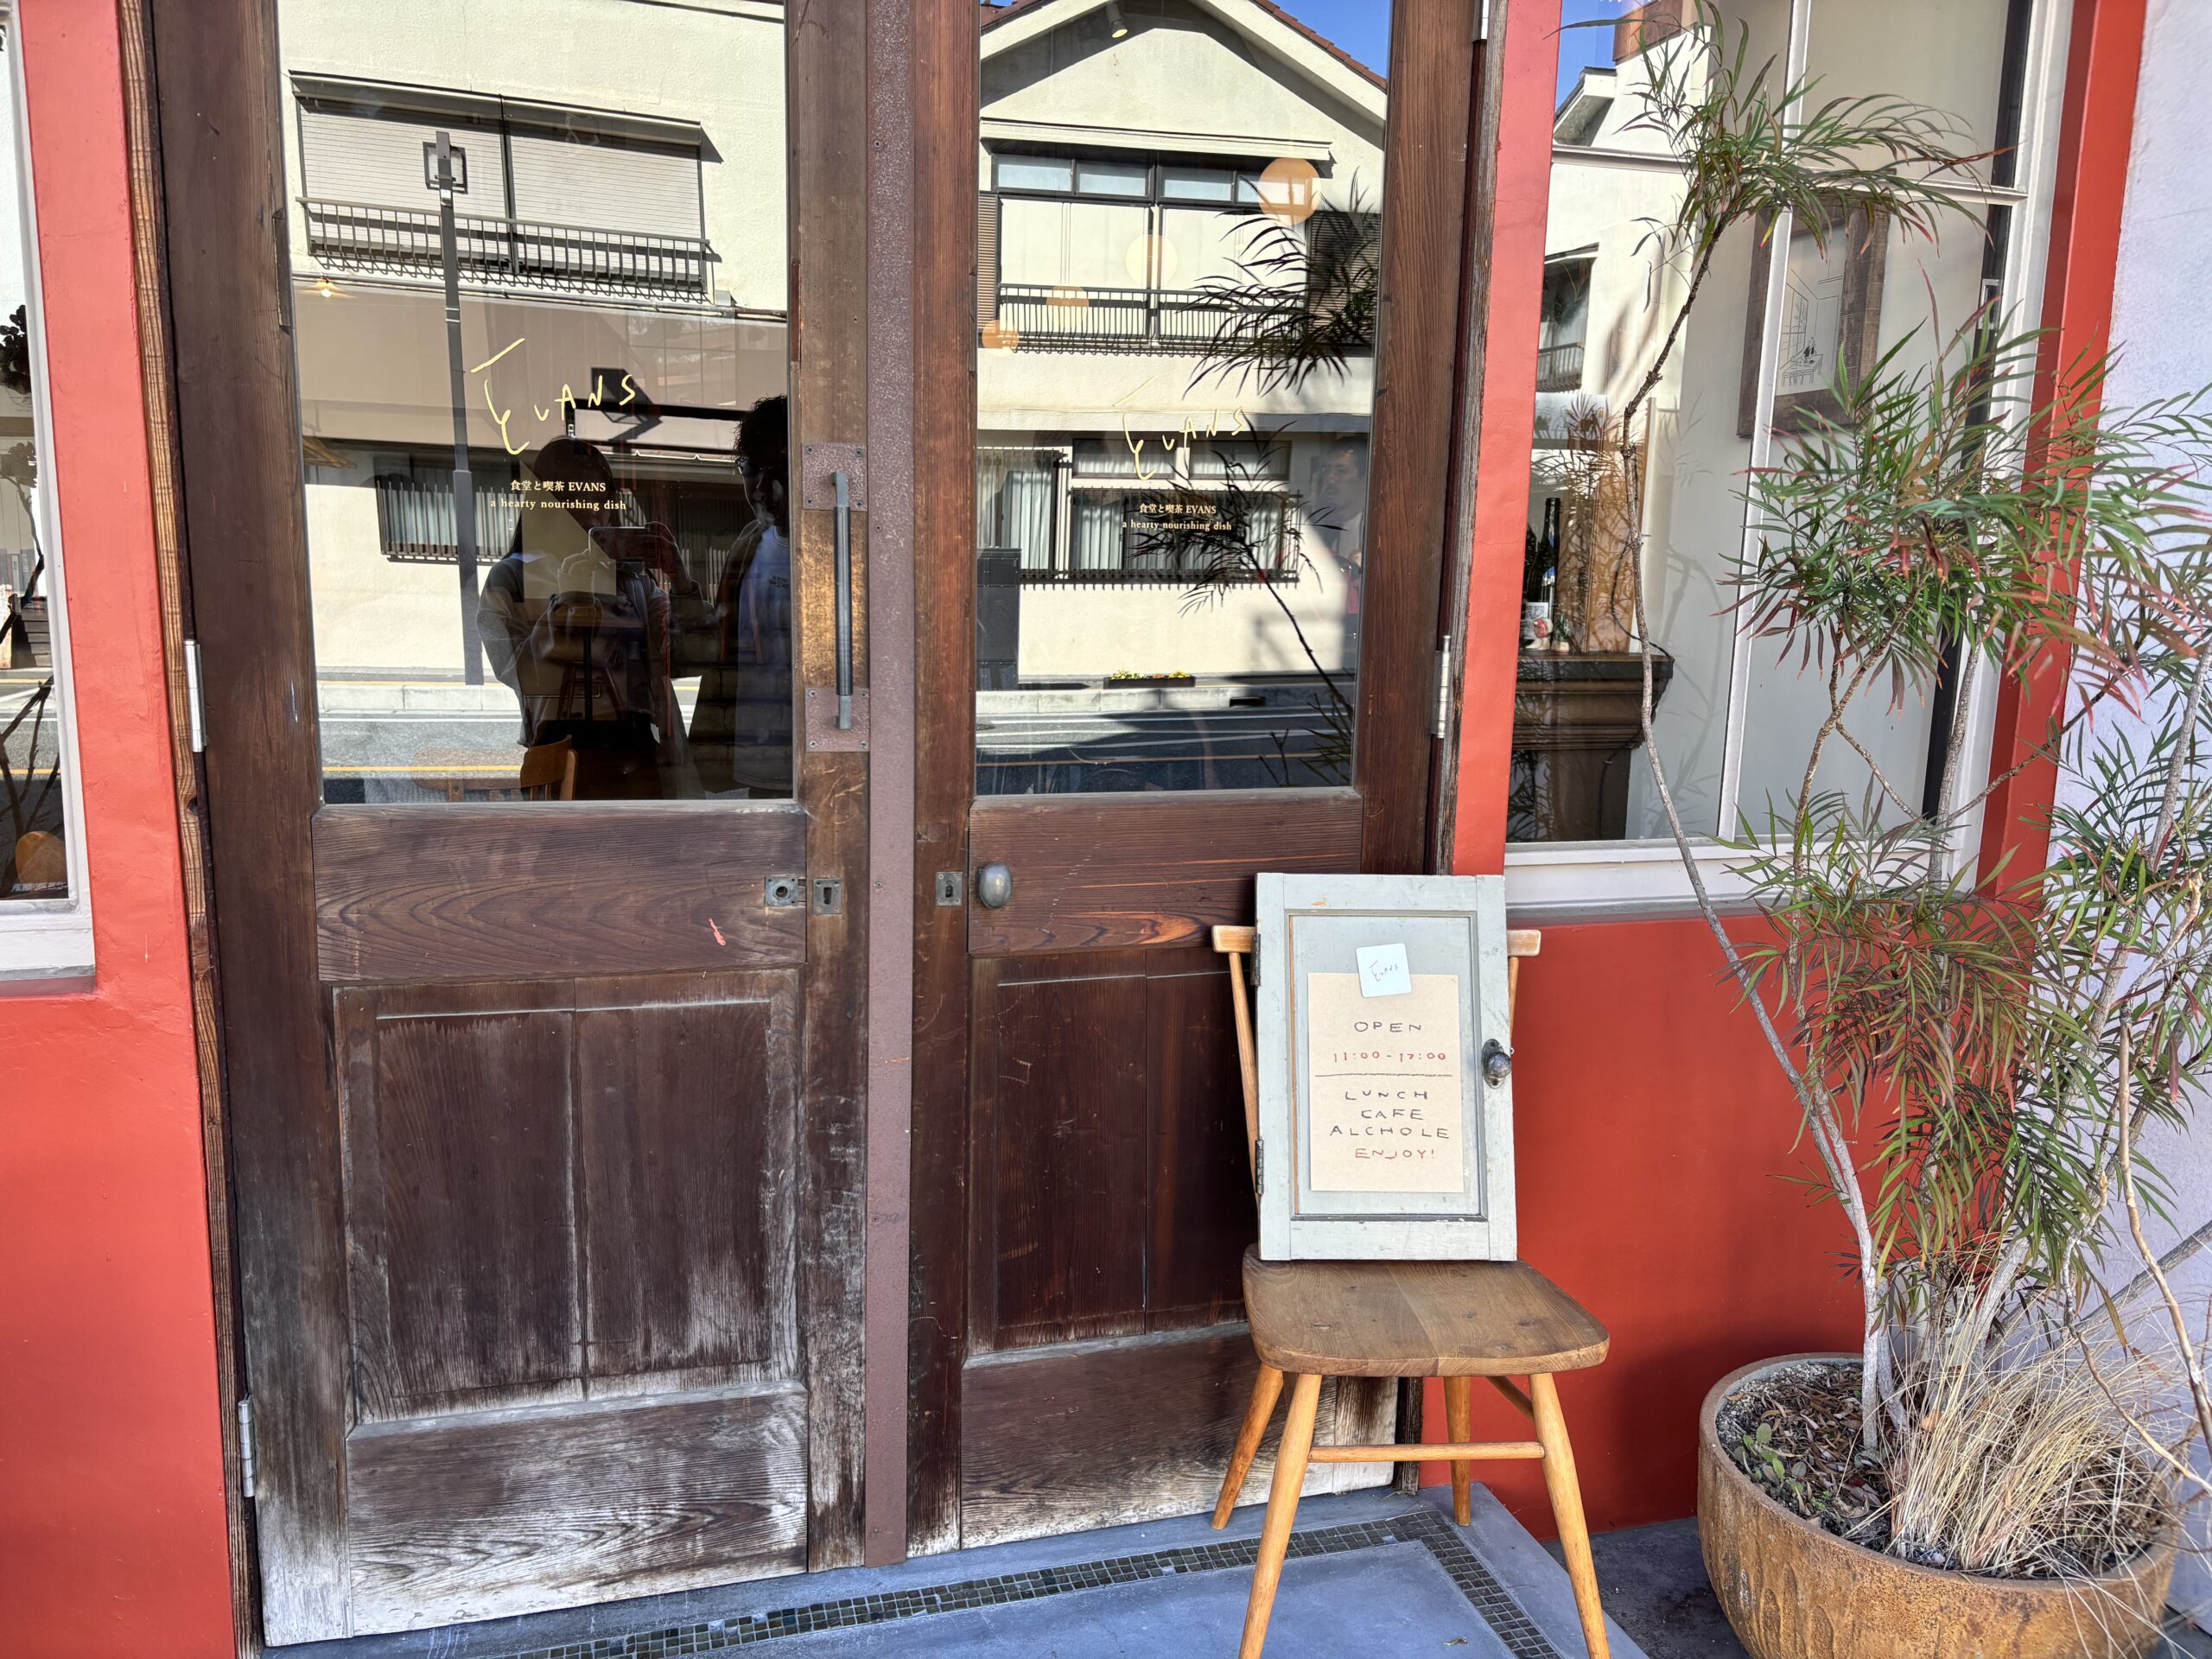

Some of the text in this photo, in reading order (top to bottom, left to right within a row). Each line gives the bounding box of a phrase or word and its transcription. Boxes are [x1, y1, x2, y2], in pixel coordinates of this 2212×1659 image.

[510, 479, 607, 493] 食堂と喫茶 EVANS
[490, 497, 626, 512] a hearty nourishing dish
[1139, 502, 1217, 515] 食堂と喫茶 EVANS
[1130, 518, 1160, 531] hearty
[1162, 520, 1211, 532] nourishing
[1213, 521, 1232, 531] dish
[1353, 1020, 1422, 1033] OPEN
[1344, 1089, 1428, 1101] LUNCH
[1361, 1108, 1424, 1121] CAFE
[1329, 1125, 1450, 1140] ALCHOLE
[1355, 1147, 1435, 1160] ENJOY!
